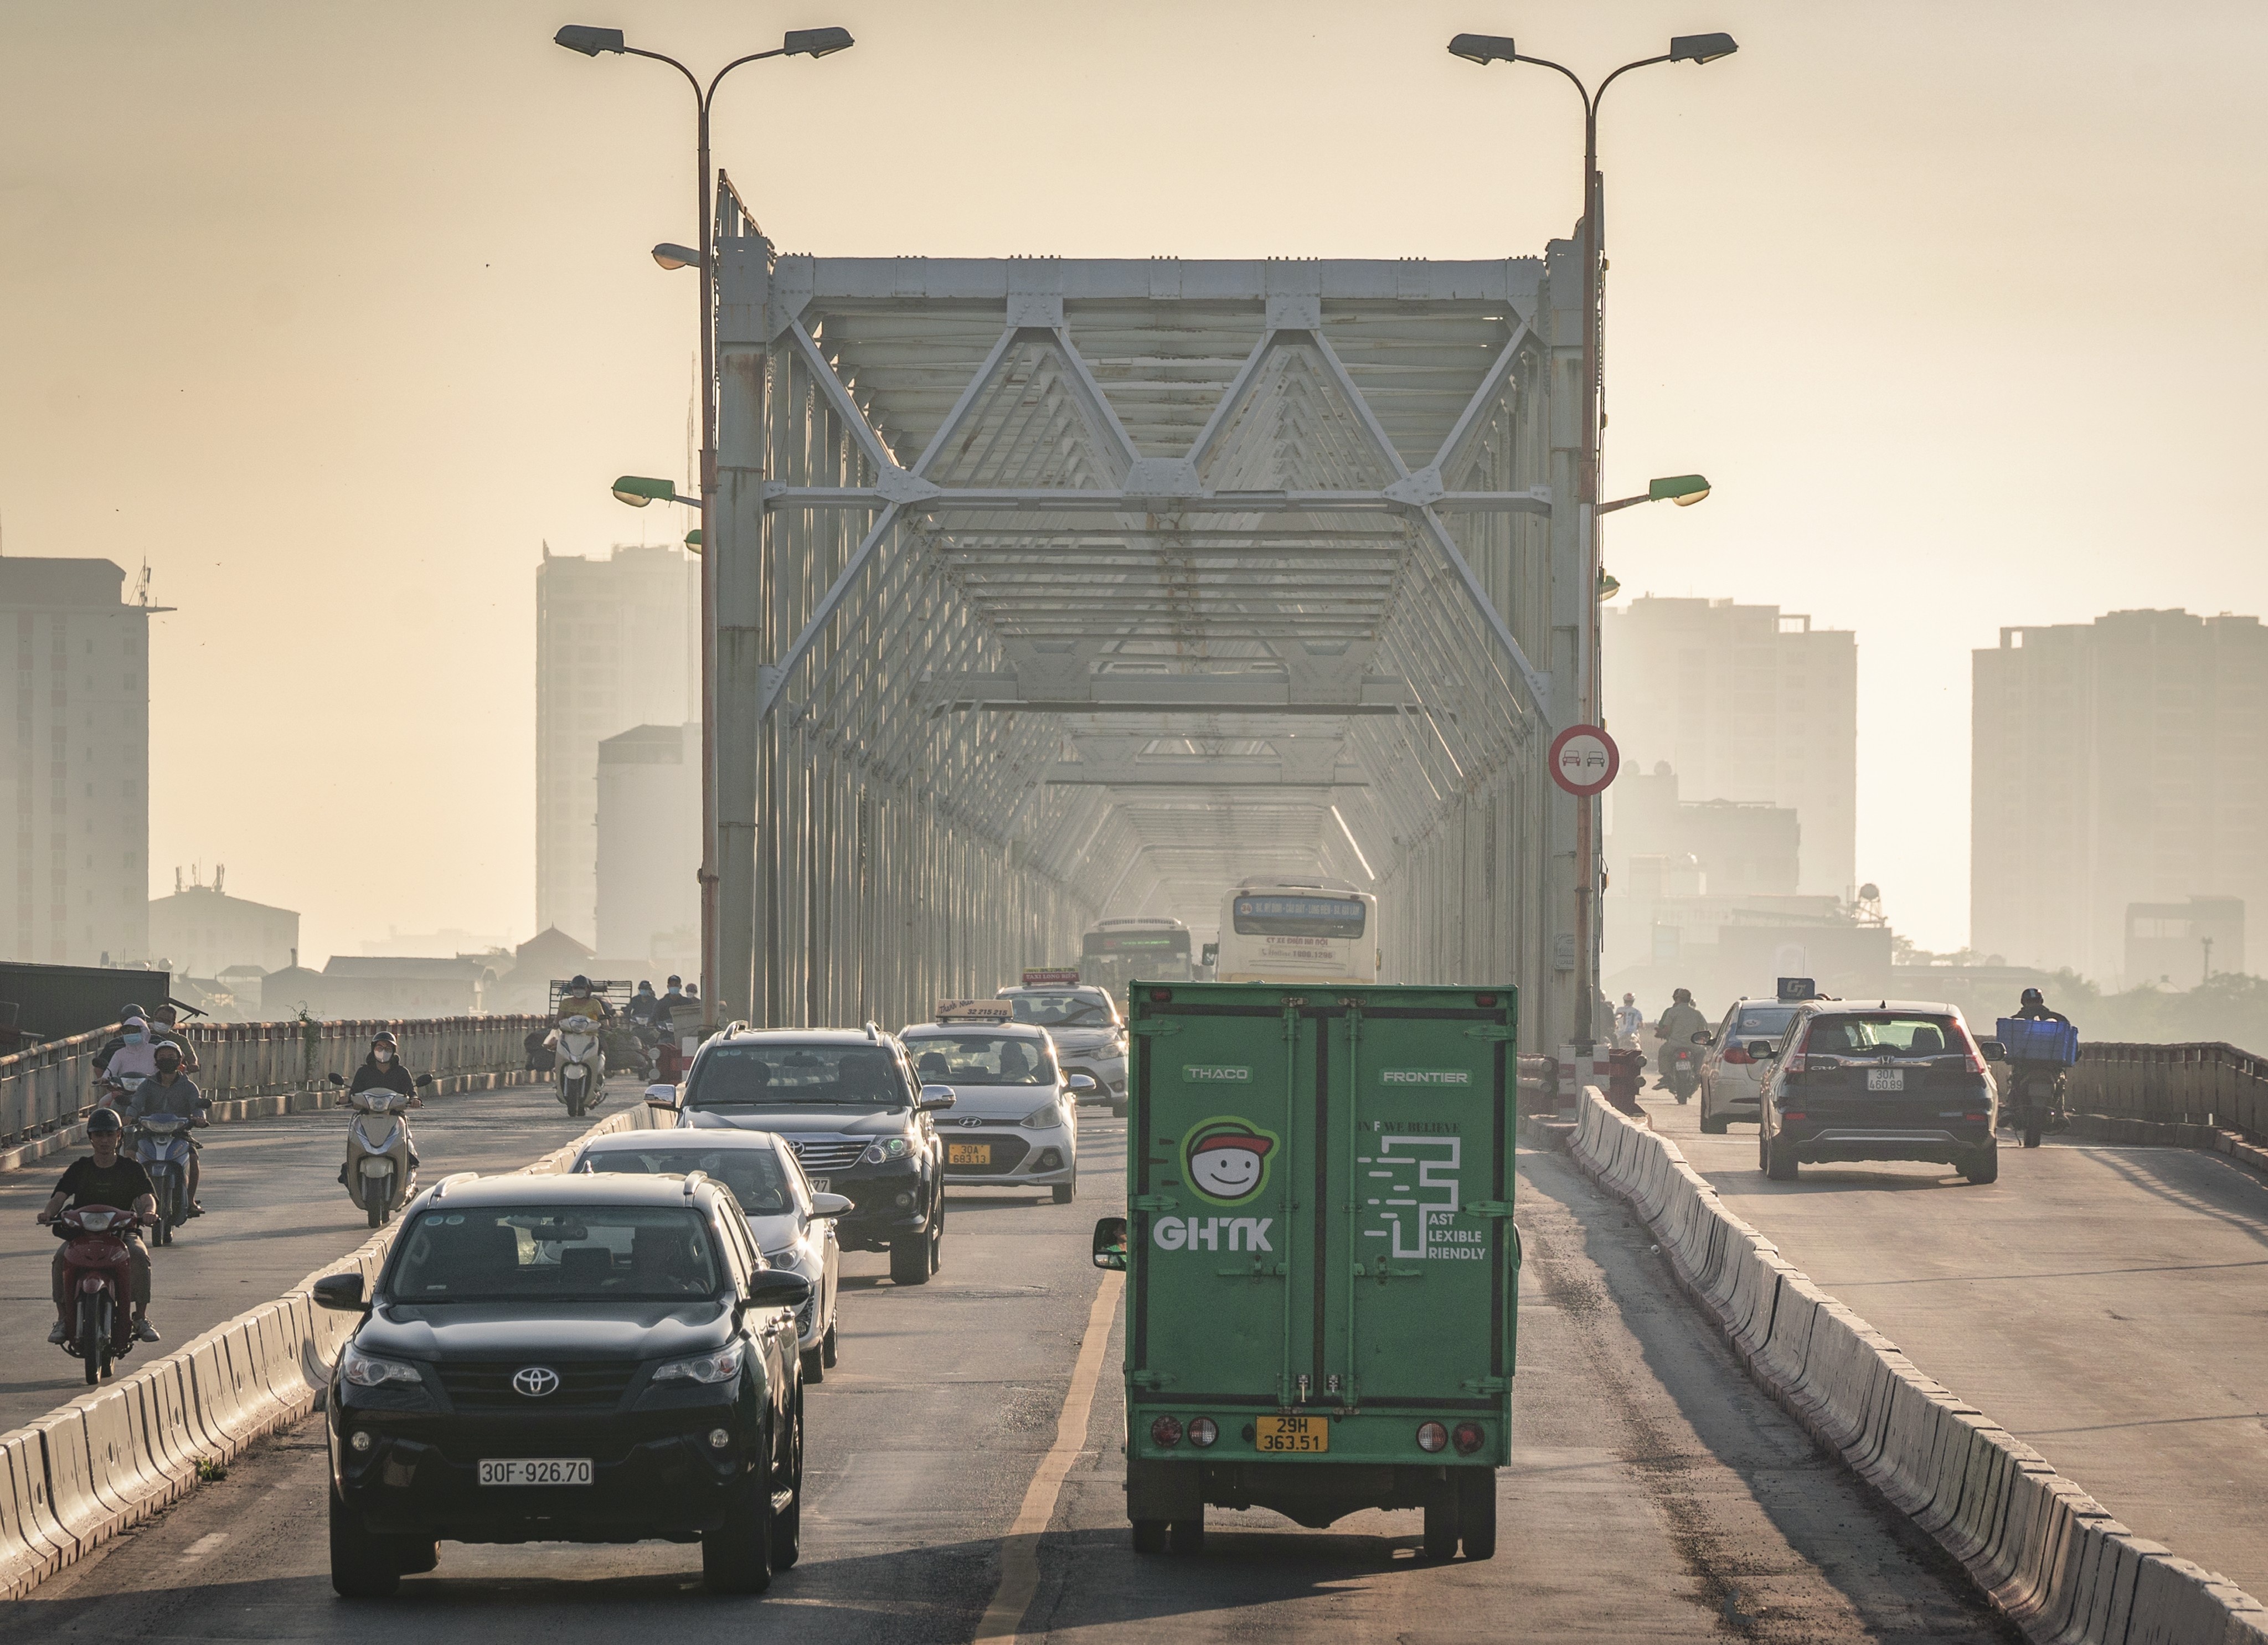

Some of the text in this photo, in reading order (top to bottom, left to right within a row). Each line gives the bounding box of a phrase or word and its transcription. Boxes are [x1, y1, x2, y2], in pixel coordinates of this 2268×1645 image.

[939, 1000, 957, 1014] Thanh
[1189, 1069, 1248, 1079] THACO
[1383, 1071, 1468, 1083] FRONTIER
[1876, 1069, 1895, 1079] 30A
[1869, 1080, 1903, 1089] 460.89
[1374, 1121, 1380, 1132] F
[1384, 1122, 1404, 1132] WE
[1407, 1122, 1461, 1133] BELIEVE
[961, 1145, 979, 1154] 30A
[953, 1154, 986, 1163] 683.13
[1153, 1216, 1274, 1251] GHTK
[1429, 1230, 1482, 1243] LEXIBLE
[1429, 1247, 1486, 1260] RIENDLY
[1276, 1418, 1308, 1433] 29H
[1264, 1435, 1319, 1450] 363.51
[482, 1462, 590, 1483] 30F-926.70
